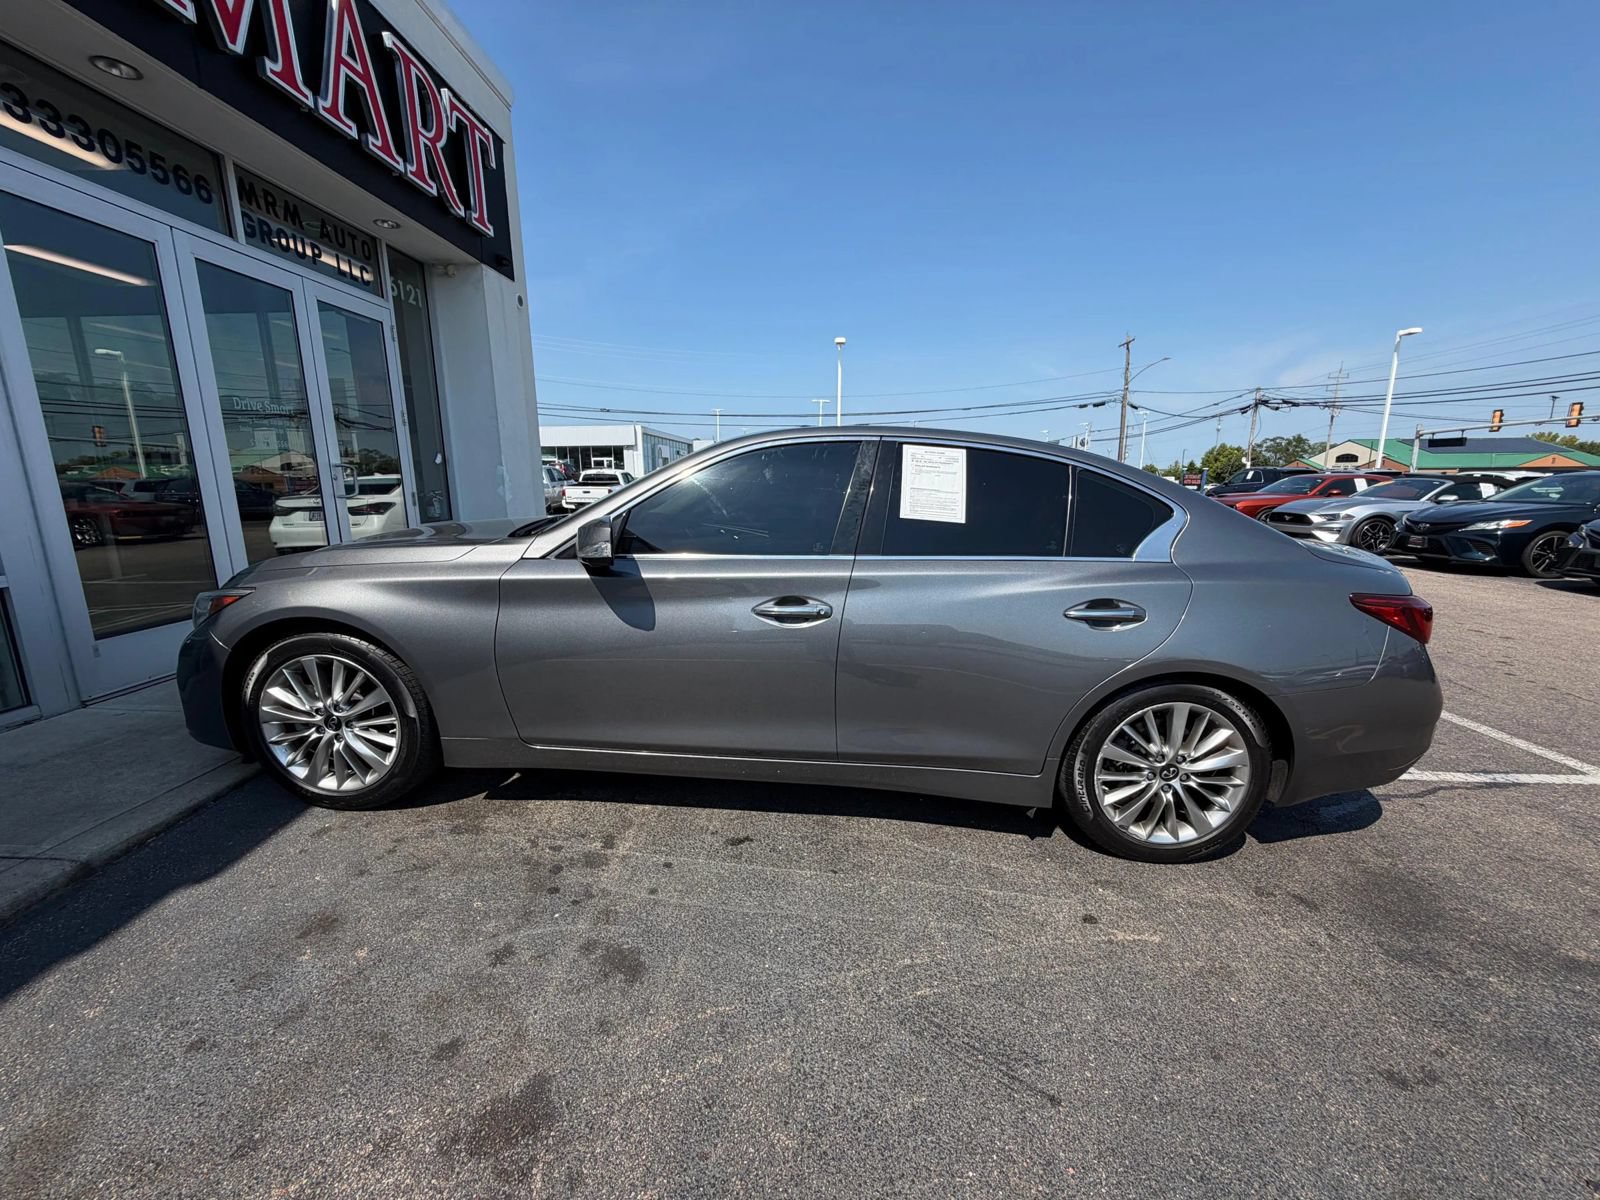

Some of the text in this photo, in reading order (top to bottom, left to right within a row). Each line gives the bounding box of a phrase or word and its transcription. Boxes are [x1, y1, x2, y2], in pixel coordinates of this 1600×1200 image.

[1, 82, 213, 204] 33305566
[237, 176, 372, 261] MRM AUTO
[241, 210, 372, 286] GROUP LLC
